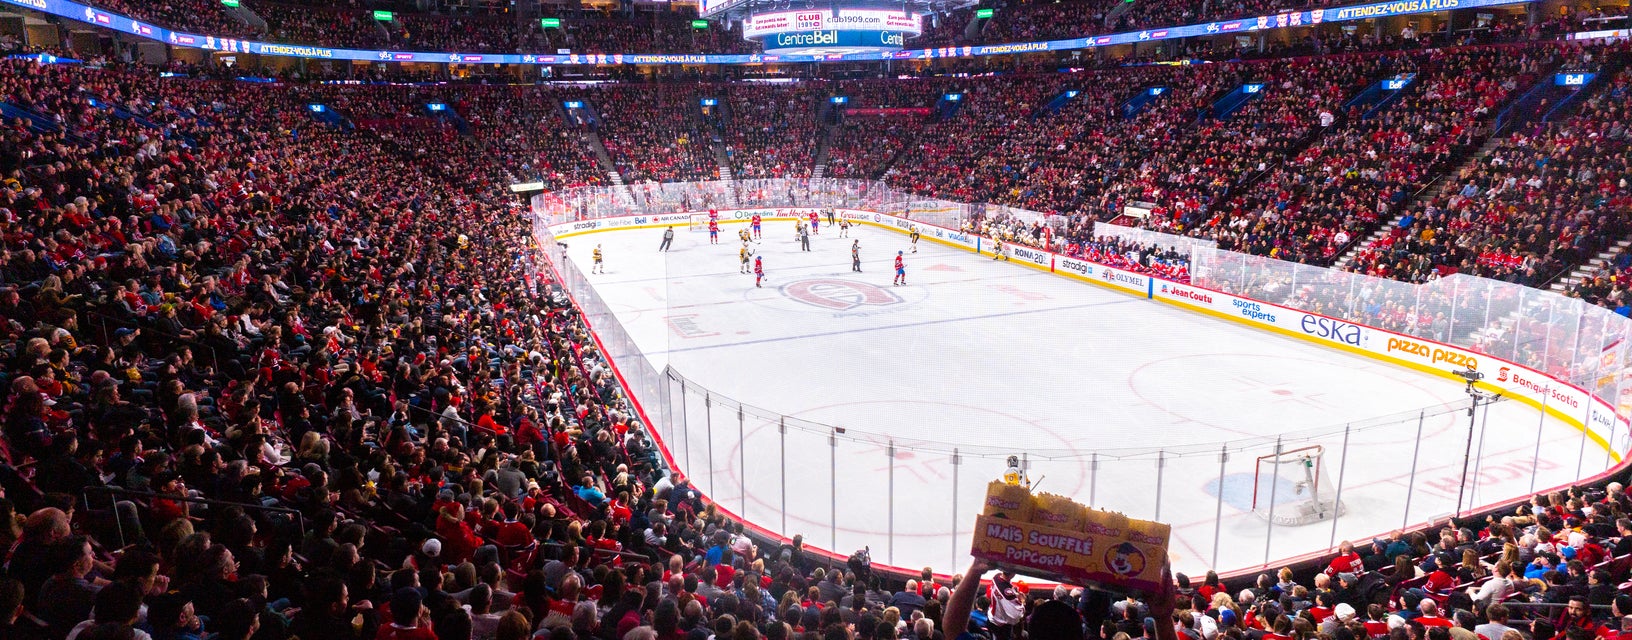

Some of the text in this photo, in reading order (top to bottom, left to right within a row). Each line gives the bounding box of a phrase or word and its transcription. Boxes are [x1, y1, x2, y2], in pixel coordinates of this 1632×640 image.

[1338, 1, 1419, 19] ATTENDEZ-VOUS
[827, 15, 881, 23] club1909.com
[316, 49, 332, 57] PLUS
[1032, 42, 1048, 50] PLUS
[690, 55, 706, 63] PLUS
[1566, 74, 1584, 85] Bell
[634, 217, 647, 225] Bell
[1015, 248, 1034, 260] RONA
[1034, 253, 1044, 264] 20
[1062, 259, 1088, 274] stradigi
[1116, 273, 1144, 287] OLYMEL
[1171, 286, 1213, 304] Jean Coutu
[1232, 298, 1261, 312] sports
[1242, 307, 1276, 323] experts
[1301, 314, 1361, 346] eska
[1387, 337, 1478, 370] pizza pizza
[1513, 373, 1579, 409] Banque Scotia
[986, 522, 1093, 556] MAÏS SOUFFLÉ
[1006, 546, 1066, 567] POPCORN
